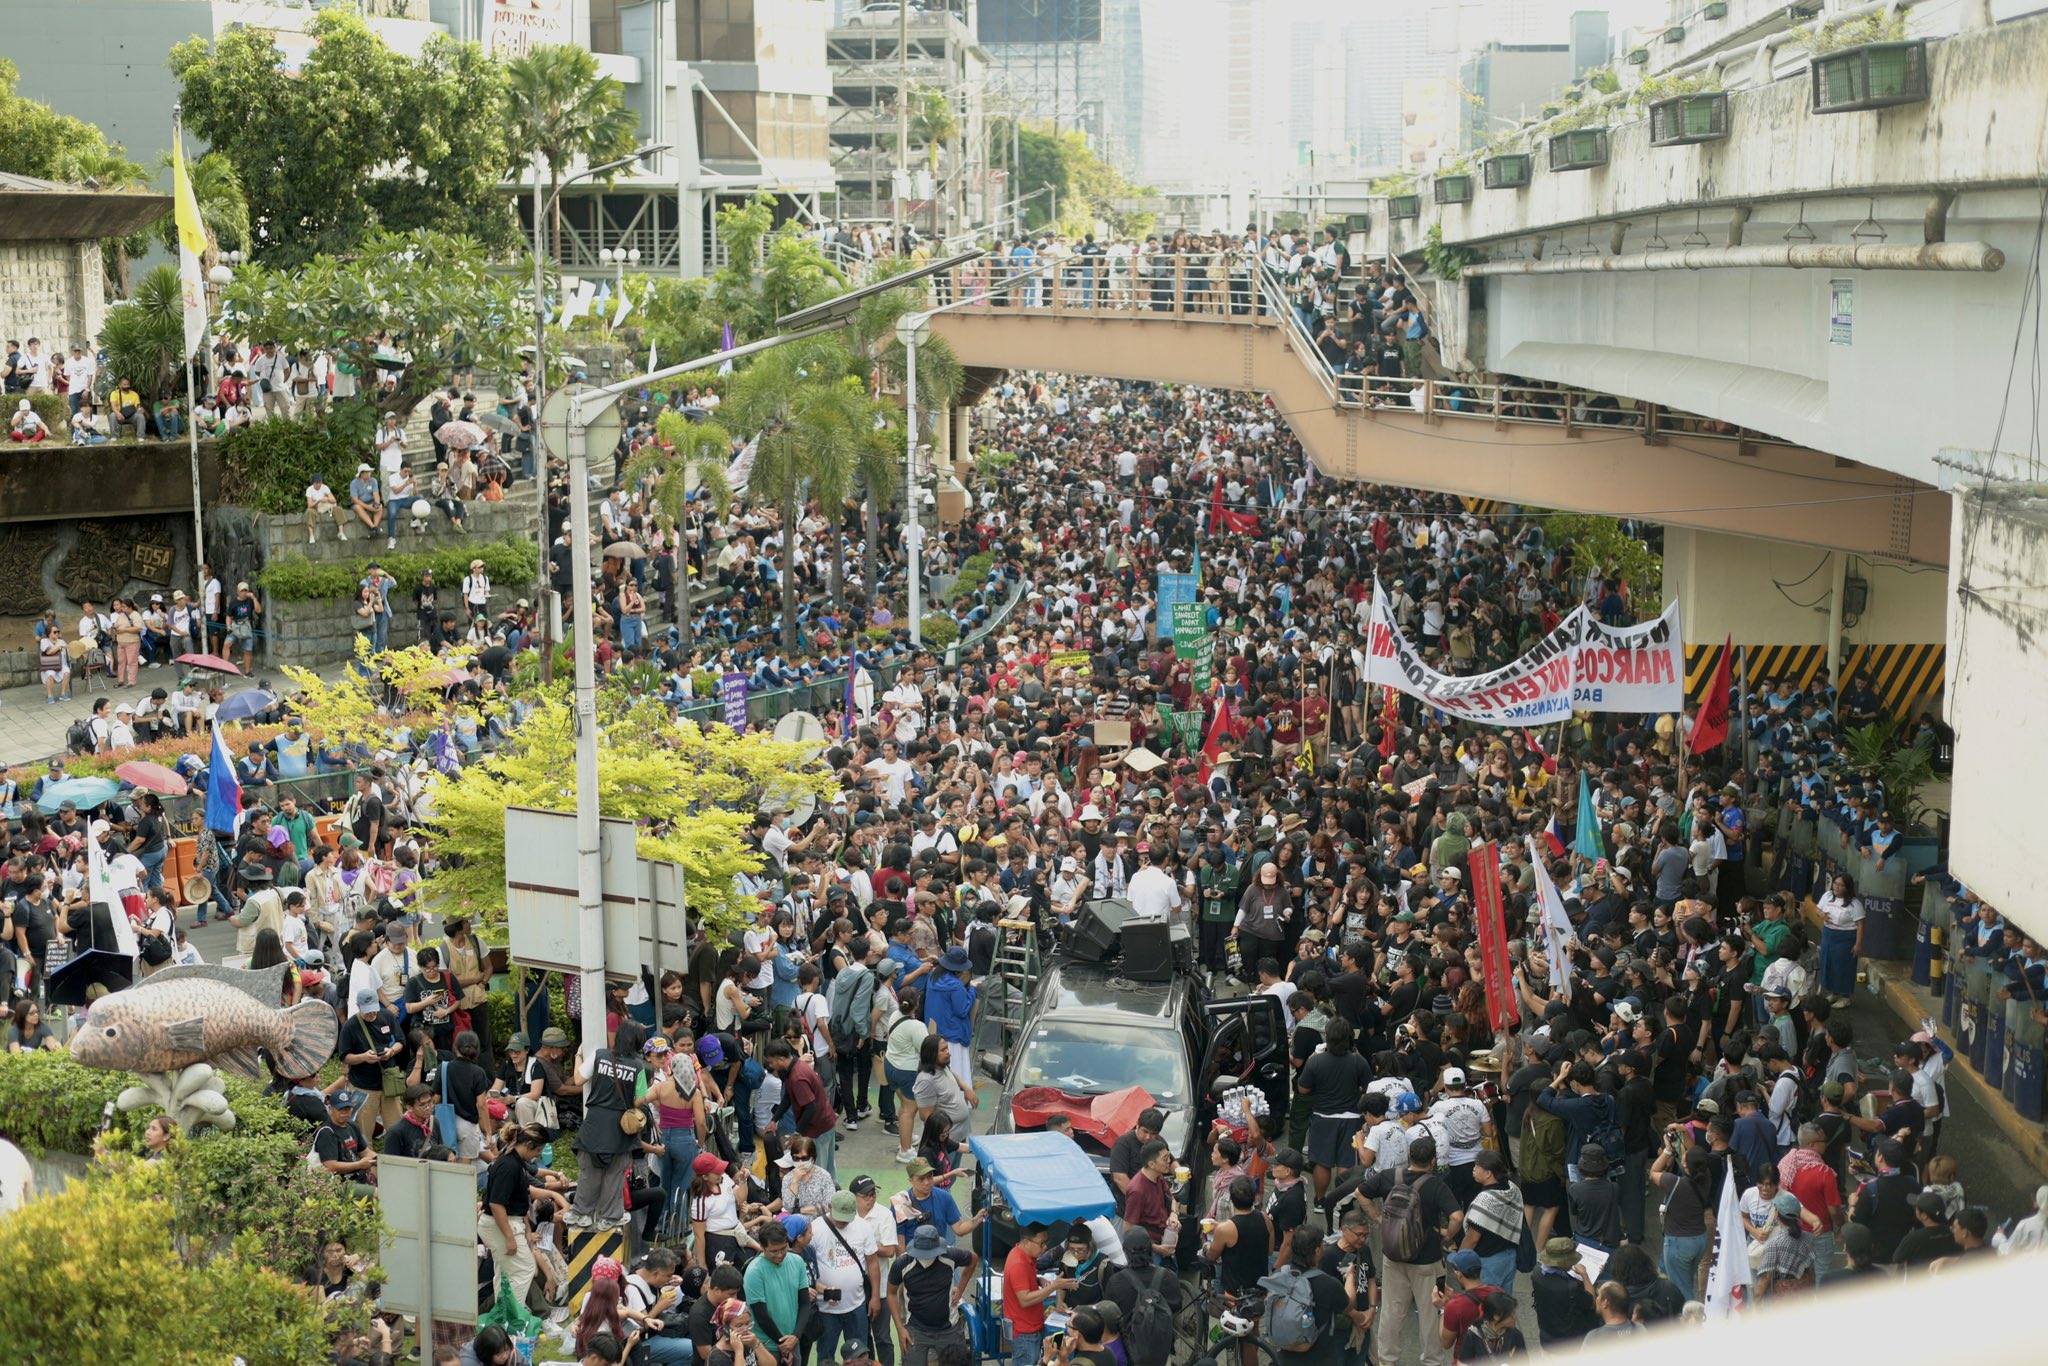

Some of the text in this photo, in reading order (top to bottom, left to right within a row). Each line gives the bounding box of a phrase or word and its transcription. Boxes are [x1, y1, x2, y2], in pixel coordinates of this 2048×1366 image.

[135, 544, 170, 568] EDSA
[1864, 898, 1892, 912] PULIS
[598, 1063, 634, 1082] MEDIA
